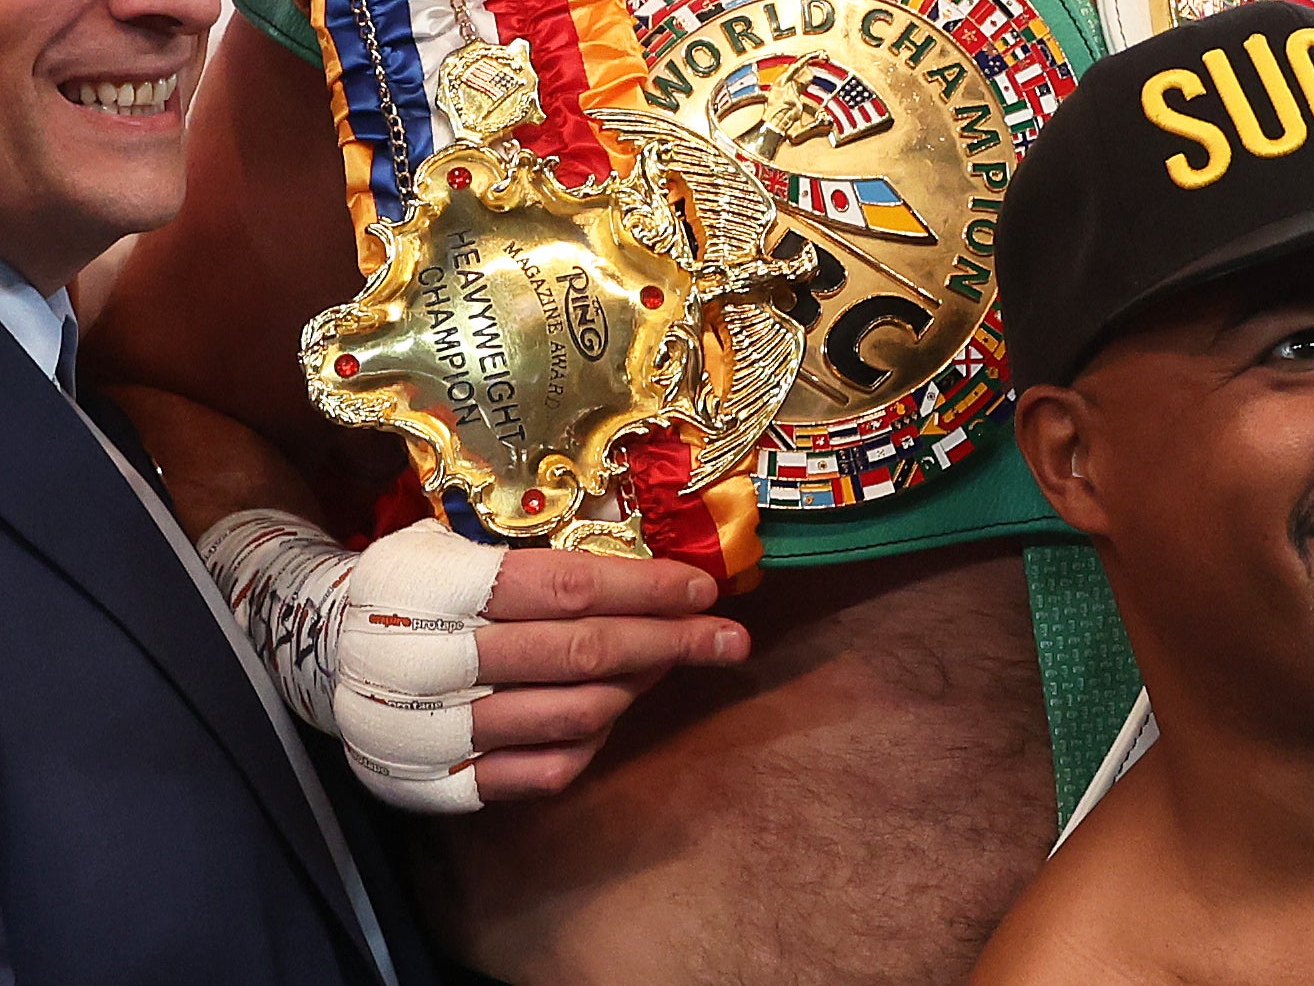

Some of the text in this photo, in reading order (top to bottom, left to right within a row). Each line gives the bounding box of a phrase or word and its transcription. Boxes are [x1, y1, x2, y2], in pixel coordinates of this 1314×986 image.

[860, 8, 1012, 305] CHAMPION
[418, 266, 482, 426] CHAMPION
[447, 229, 526, 441] HEAVYWEIGHT
[503, 241, 569, 409] MAGAZINE AWARD
[556, 266, 607, 360] RING
